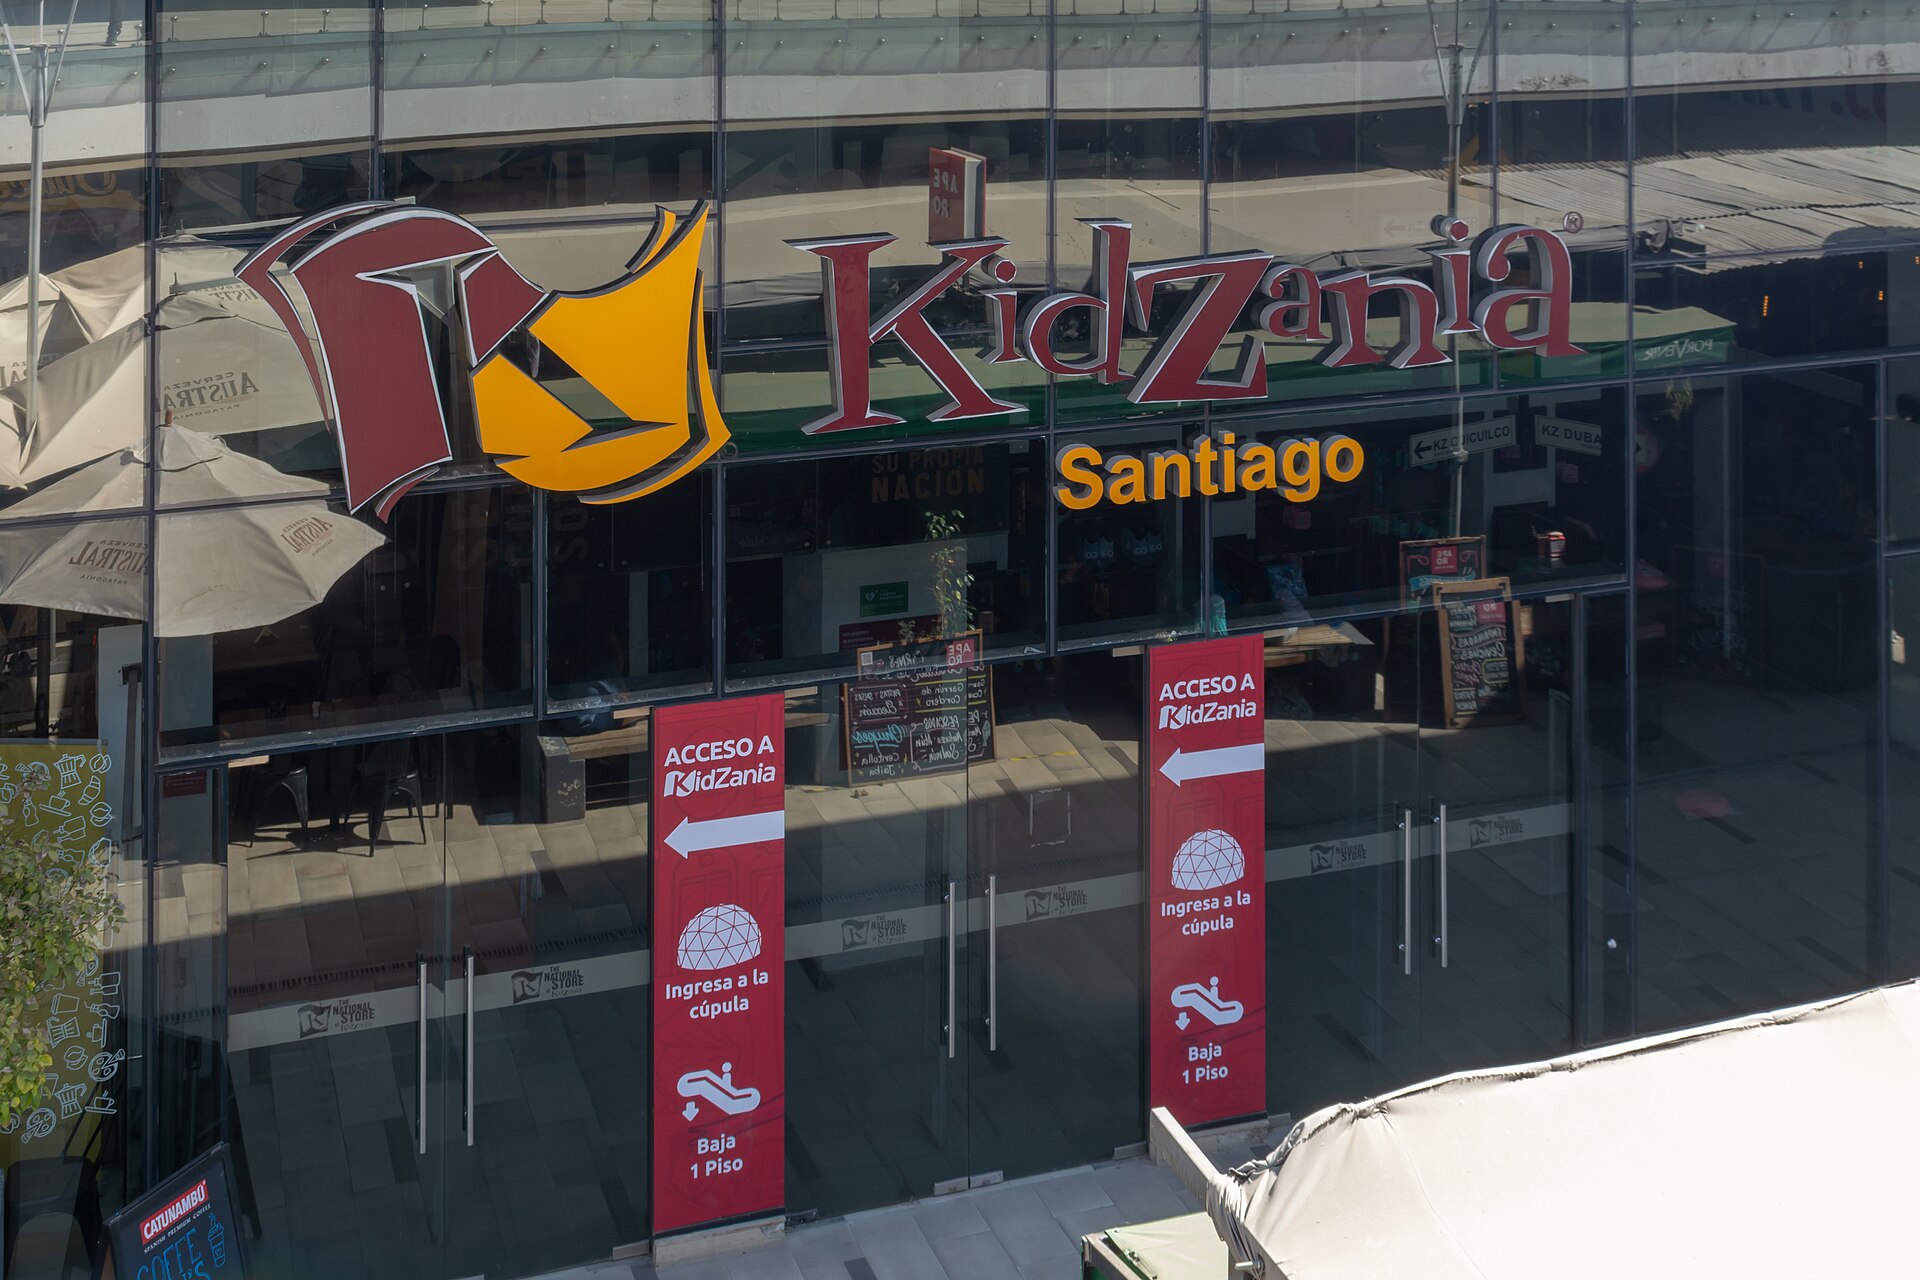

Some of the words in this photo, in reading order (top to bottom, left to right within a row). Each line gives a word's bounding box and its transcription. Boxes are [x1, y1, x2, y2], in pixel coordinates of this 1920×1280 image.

[784, 214, 1588, 435] KidZania
[1541, 423, 1560, 438] KZ
[1432, 438, 1448, 451] KZ
[871, 455, 899, 474] SU
[1054, 431, 1365, 510] Santiago
[1158, 674, 1237, 702] ACCESO
[1240, 672, 1256, 691] A
[1158, 698, 1257, 730] KidZania
[663, 737, 754, 767] ACCESO
[757, 735, 775, 754] A
[663, 762, 776, 798] KidZania
[1059, 894, 1088, 908] STORE
[1161, 896, 1220, 918] Ingresa
[1223, 895, 1233, 908] a
[1237, 890, 1251, 906] la
[871, 918, 905, 931] NATIONAL
[877, 923, 908, 938] STORE
[1181, 914, 1234, 936] cúpula
[544, 968, 582, 982] NATIONAL
[551, 974, 584, 990] STORE
[665, 976, 734, 1001] Ingresa
[737, 974, 748, 988] a
[752, 968, 769, 986] la
[332, 1001, 371, 1016] NATIONAL
[340, 1007, 375, 1024] STORE
[689, 995, 750, 1019] cúpula
[1188, 1042, 1222, 1062] Baja
[1182, 1069, 1190, 1085] 1
[1195, 1065, 1229, 1083] Piso
[697, 1133, 736, 1155] Baja
[690, 1162, 699, 1179] 1
[705, 1157, 744, 1178] Piso
